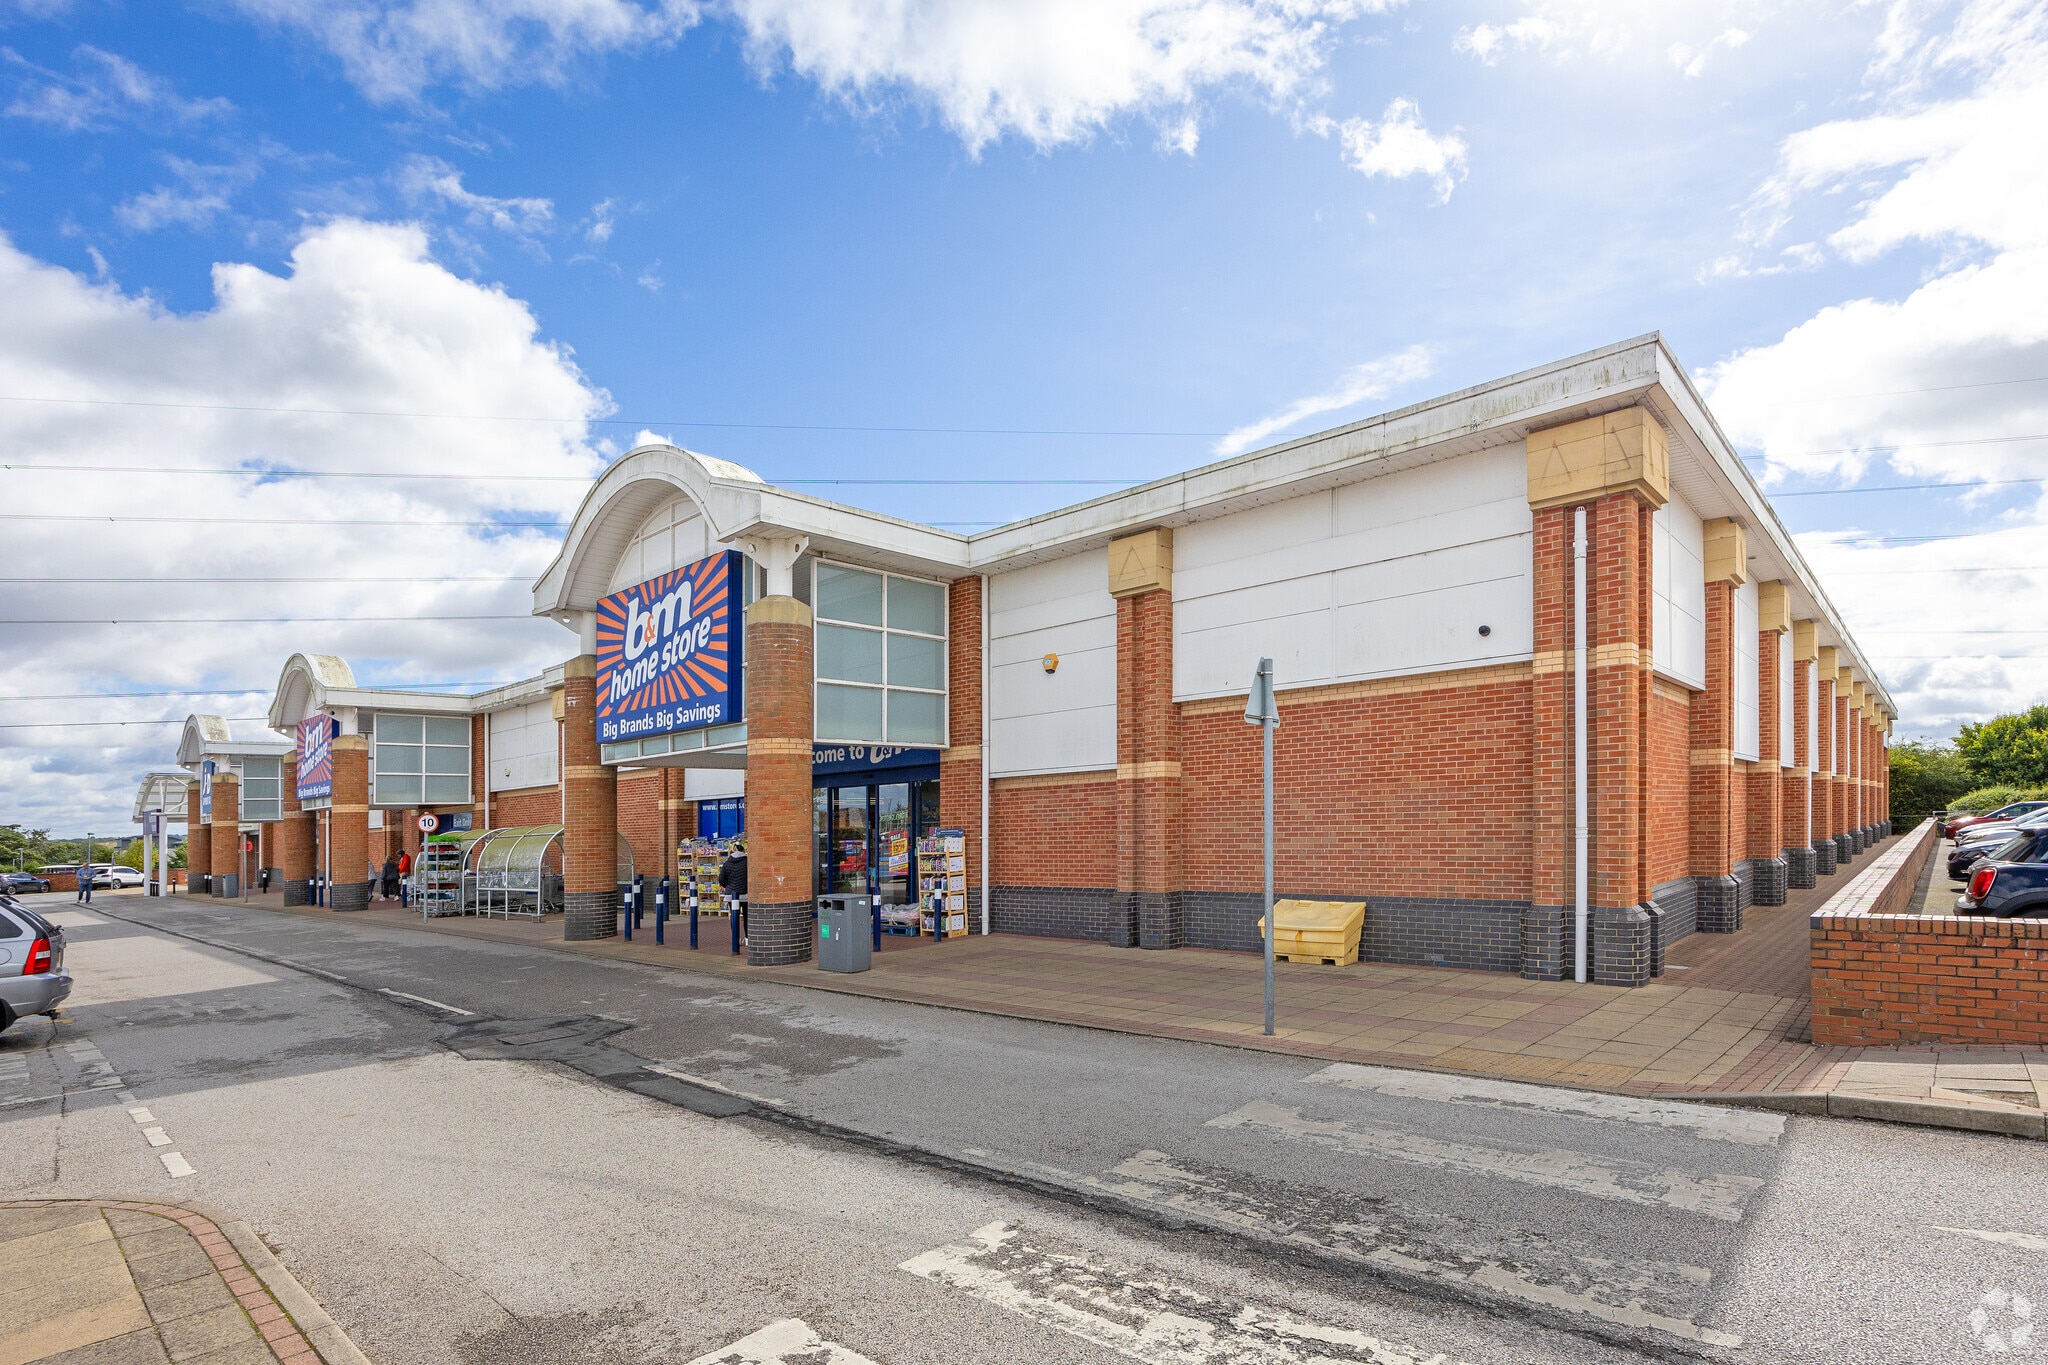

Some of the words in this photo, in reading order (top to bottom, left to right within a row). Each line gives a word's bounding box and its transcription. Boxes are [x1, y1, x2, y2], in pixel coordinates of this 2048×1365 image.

[625, 581, 692, 660] b&m
[610, 651, 658, 703] home
[661, 616, 711, 672] store
[603, 722, 617, 740] Big
[620, 713, 653, 734] Brands
[657, 710, 673, 730] Big
[676, 703, 721, 724] Savings
[849, 745, 865, 760] to
[422, 818, 434, 827] 10
